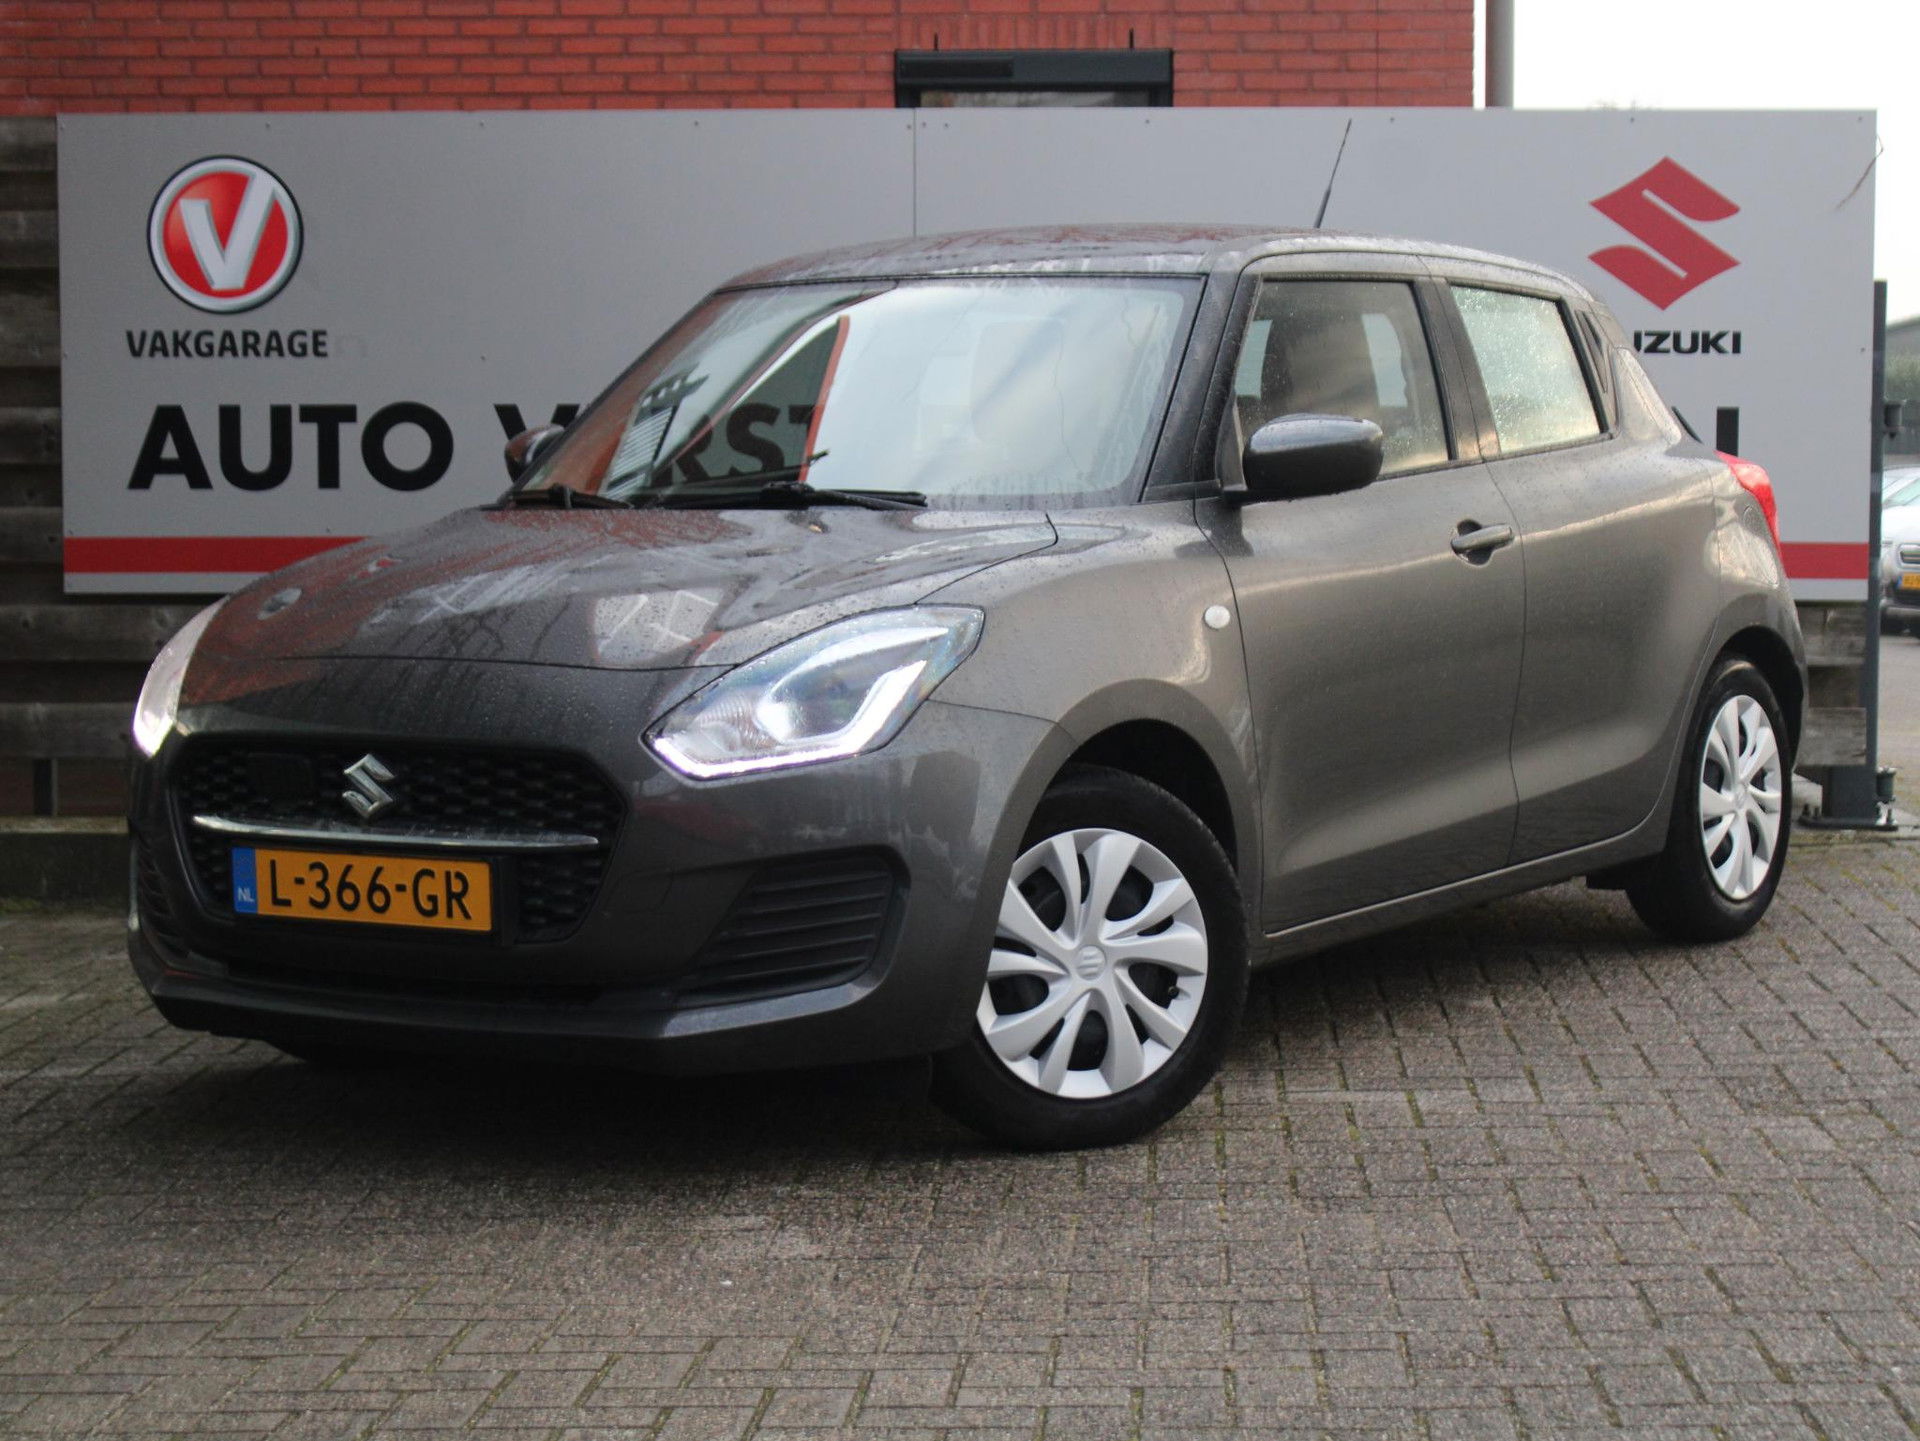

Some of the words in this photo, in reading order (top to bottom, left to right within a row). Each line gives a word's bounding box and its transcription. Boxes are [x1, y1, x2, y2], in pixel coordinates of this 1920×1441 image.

[126, 329, 328, 358] VAKGARAGE
[1633, 330, 1742, 354] ZUKI
[127, 401, 454, 492] AUTO
[237, 887, 255, 903] NL
[269, 859, 472, 920] L-366-GR
